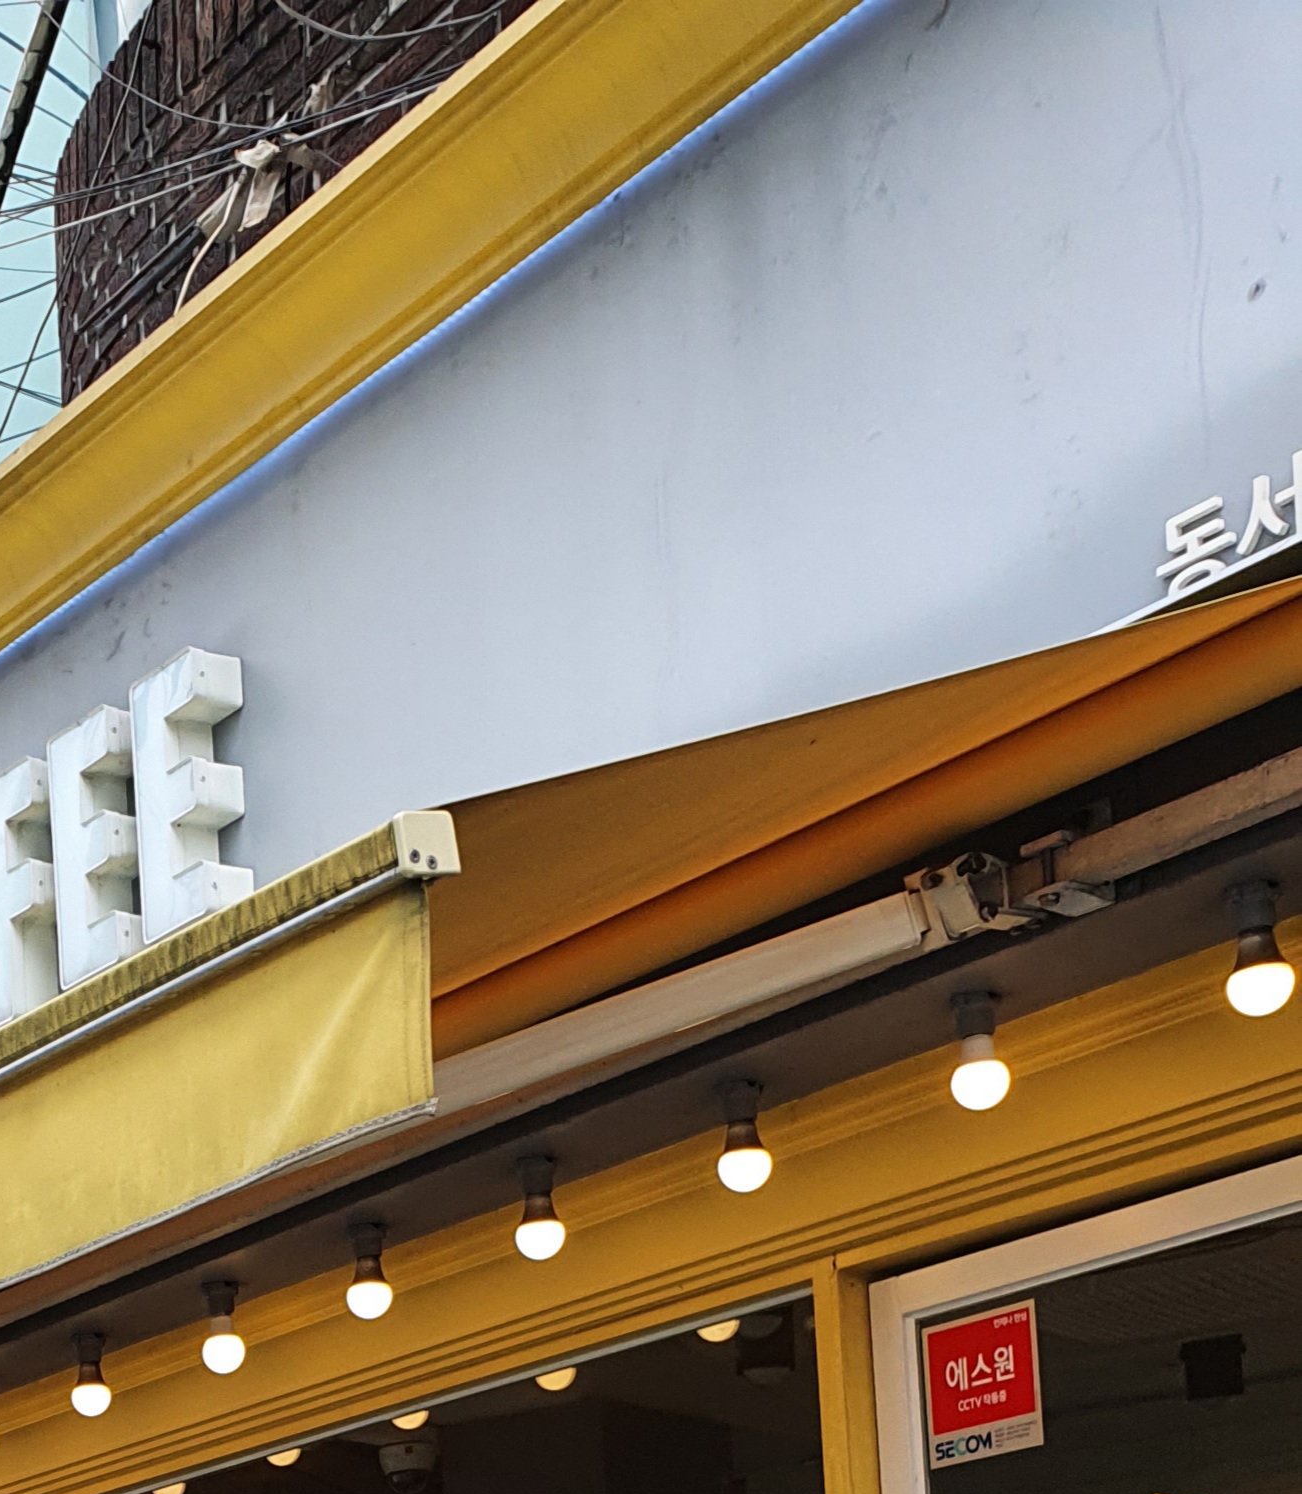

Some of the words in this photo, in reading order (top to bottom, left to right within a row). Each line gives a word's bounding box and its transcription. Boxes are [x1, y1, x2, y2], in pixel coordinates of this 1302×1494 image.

[945, 1344, 1016, 1391] 에스원
[958, 1396, 983, 1412] CCTV
[935, 1431, 993, 1461] SECOM
